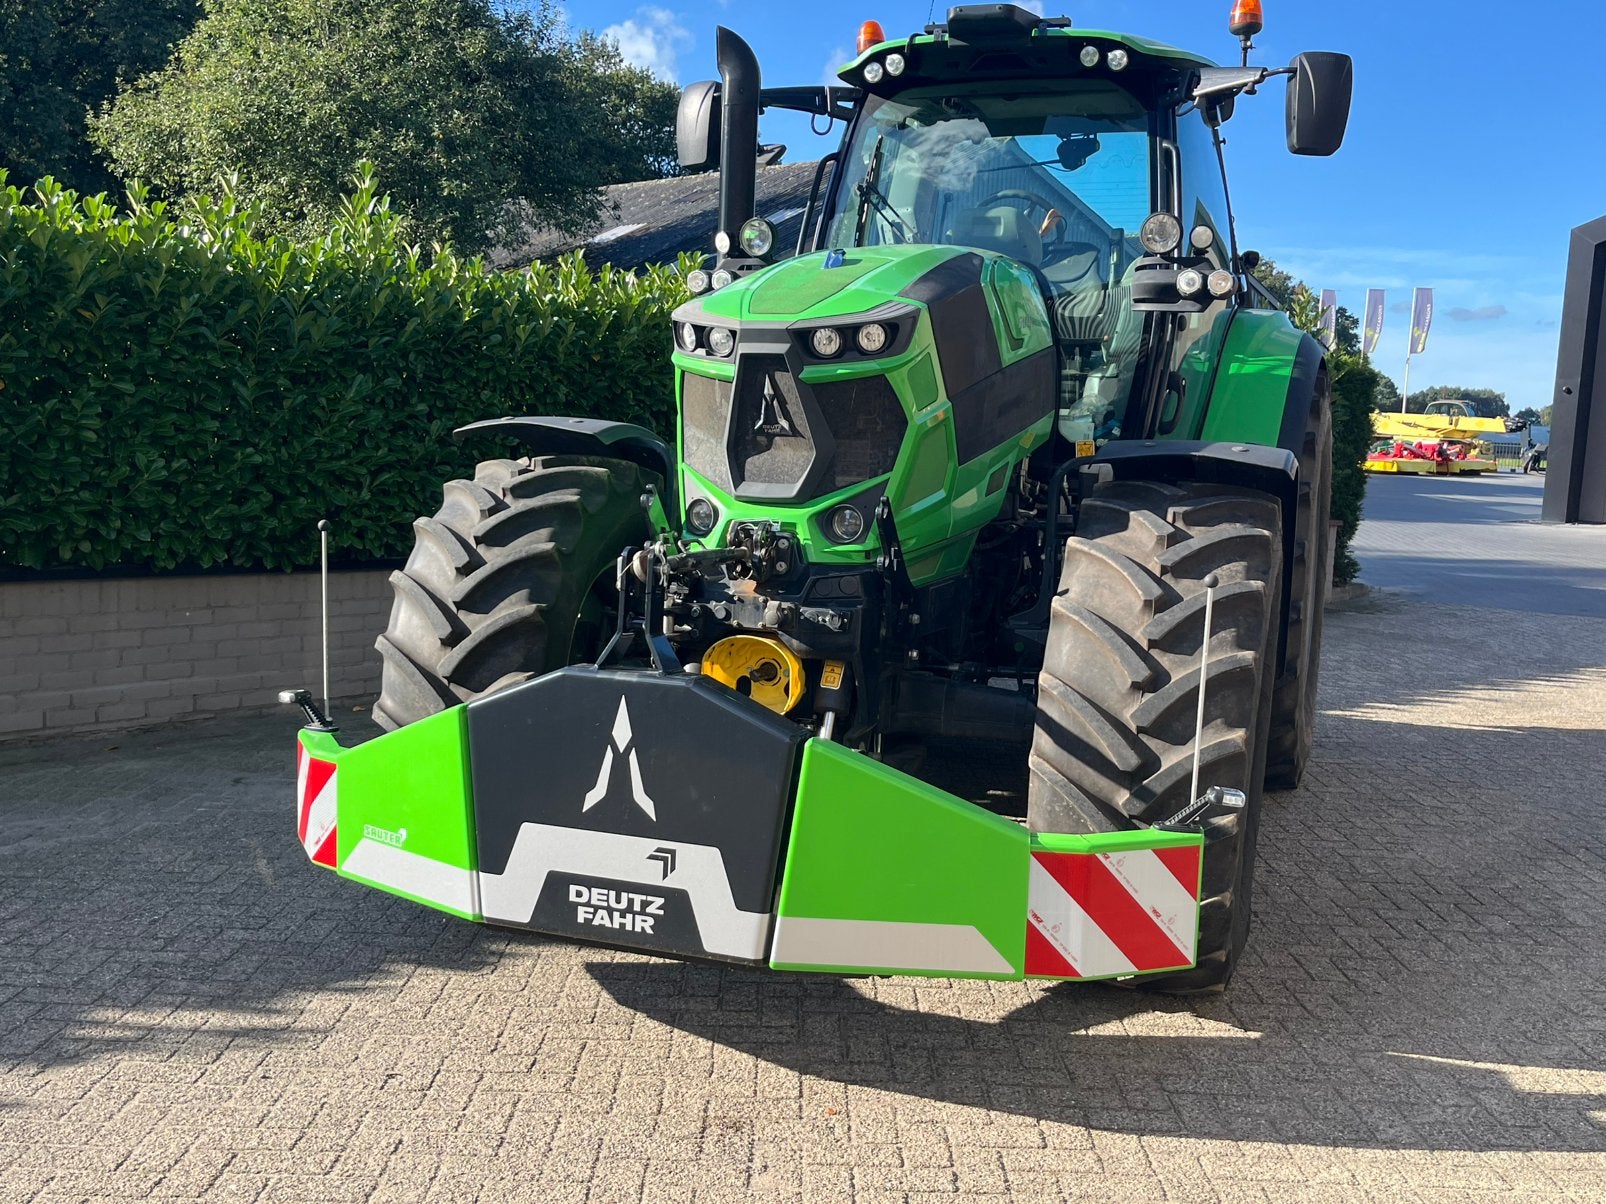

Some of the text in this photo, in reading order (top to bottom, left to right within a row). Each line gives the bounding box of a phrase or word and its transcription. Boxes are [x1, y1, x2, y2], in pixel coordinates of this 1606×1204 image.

[364, 825, 402, 846] SAUTER
[568, 884, 665, 915] DEUTZ
[577, 905, 655, 934] FAHR
